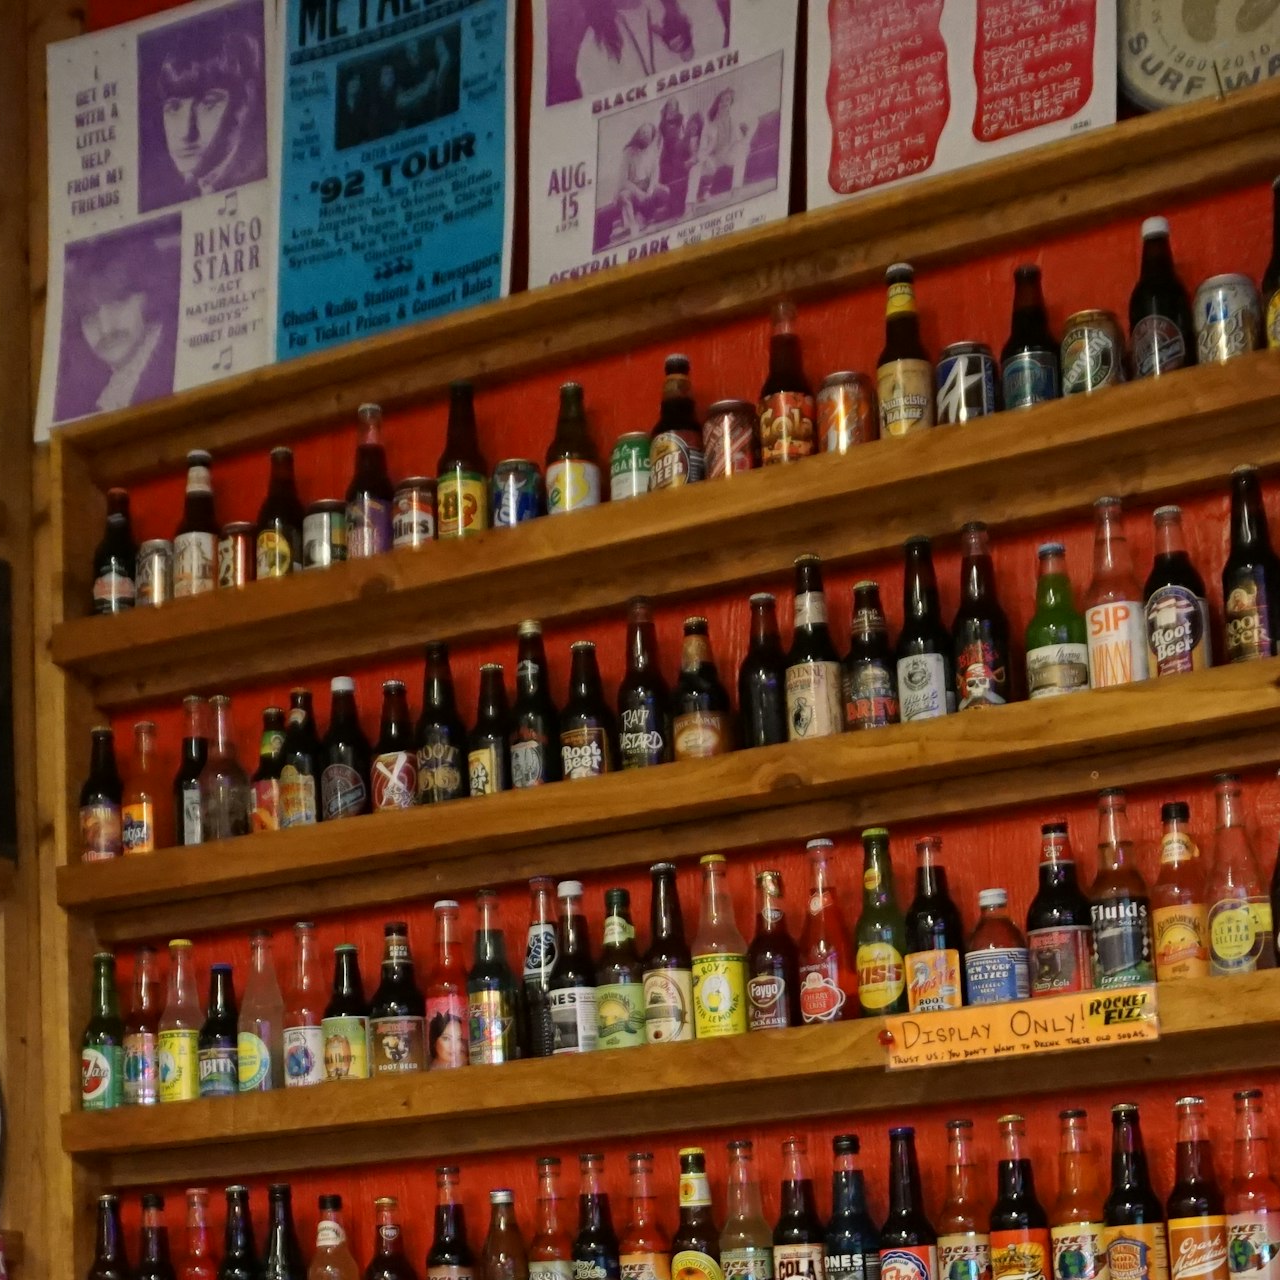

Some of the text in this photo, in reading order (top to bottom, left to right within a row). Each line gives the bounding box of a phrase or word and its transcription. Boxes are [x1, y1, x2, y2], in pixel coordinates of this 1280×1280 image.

[1127, 31, 1206, 97] SURF
[591, 50, 739, 115] BLACK SABBATH
[373, 132, 477, 187] TOUR
[548, 162, 593, 197] AUG.
[561, 192, 579, 220] 15
[193, 216, 262, 258] RINGO
[627, 236, 670, 262] PARK
[192, 244, 260, 287] STARR
[1089, 606, 1131, 636] SIP
[561, 741, 601, 760] Root
[564, 754, 602, 772] Beer
[856, 964, 904, 987] KISS
[1089, 993, 1148, 1017] ROCKET
[901, 1003, 1086, 1050] DISPLAY ONLY!
[891, 1055, 919, 1065] TRUST
[1034, 1039, 1060, 1049] DRINK
[1065, 1037, 1090, 1045] THESE
[1095, 1033, 1111, 1042] OLD
[379, 1062, 419, 1072] ROOT BEER
[779, 1258, 816, 1280] COLA
